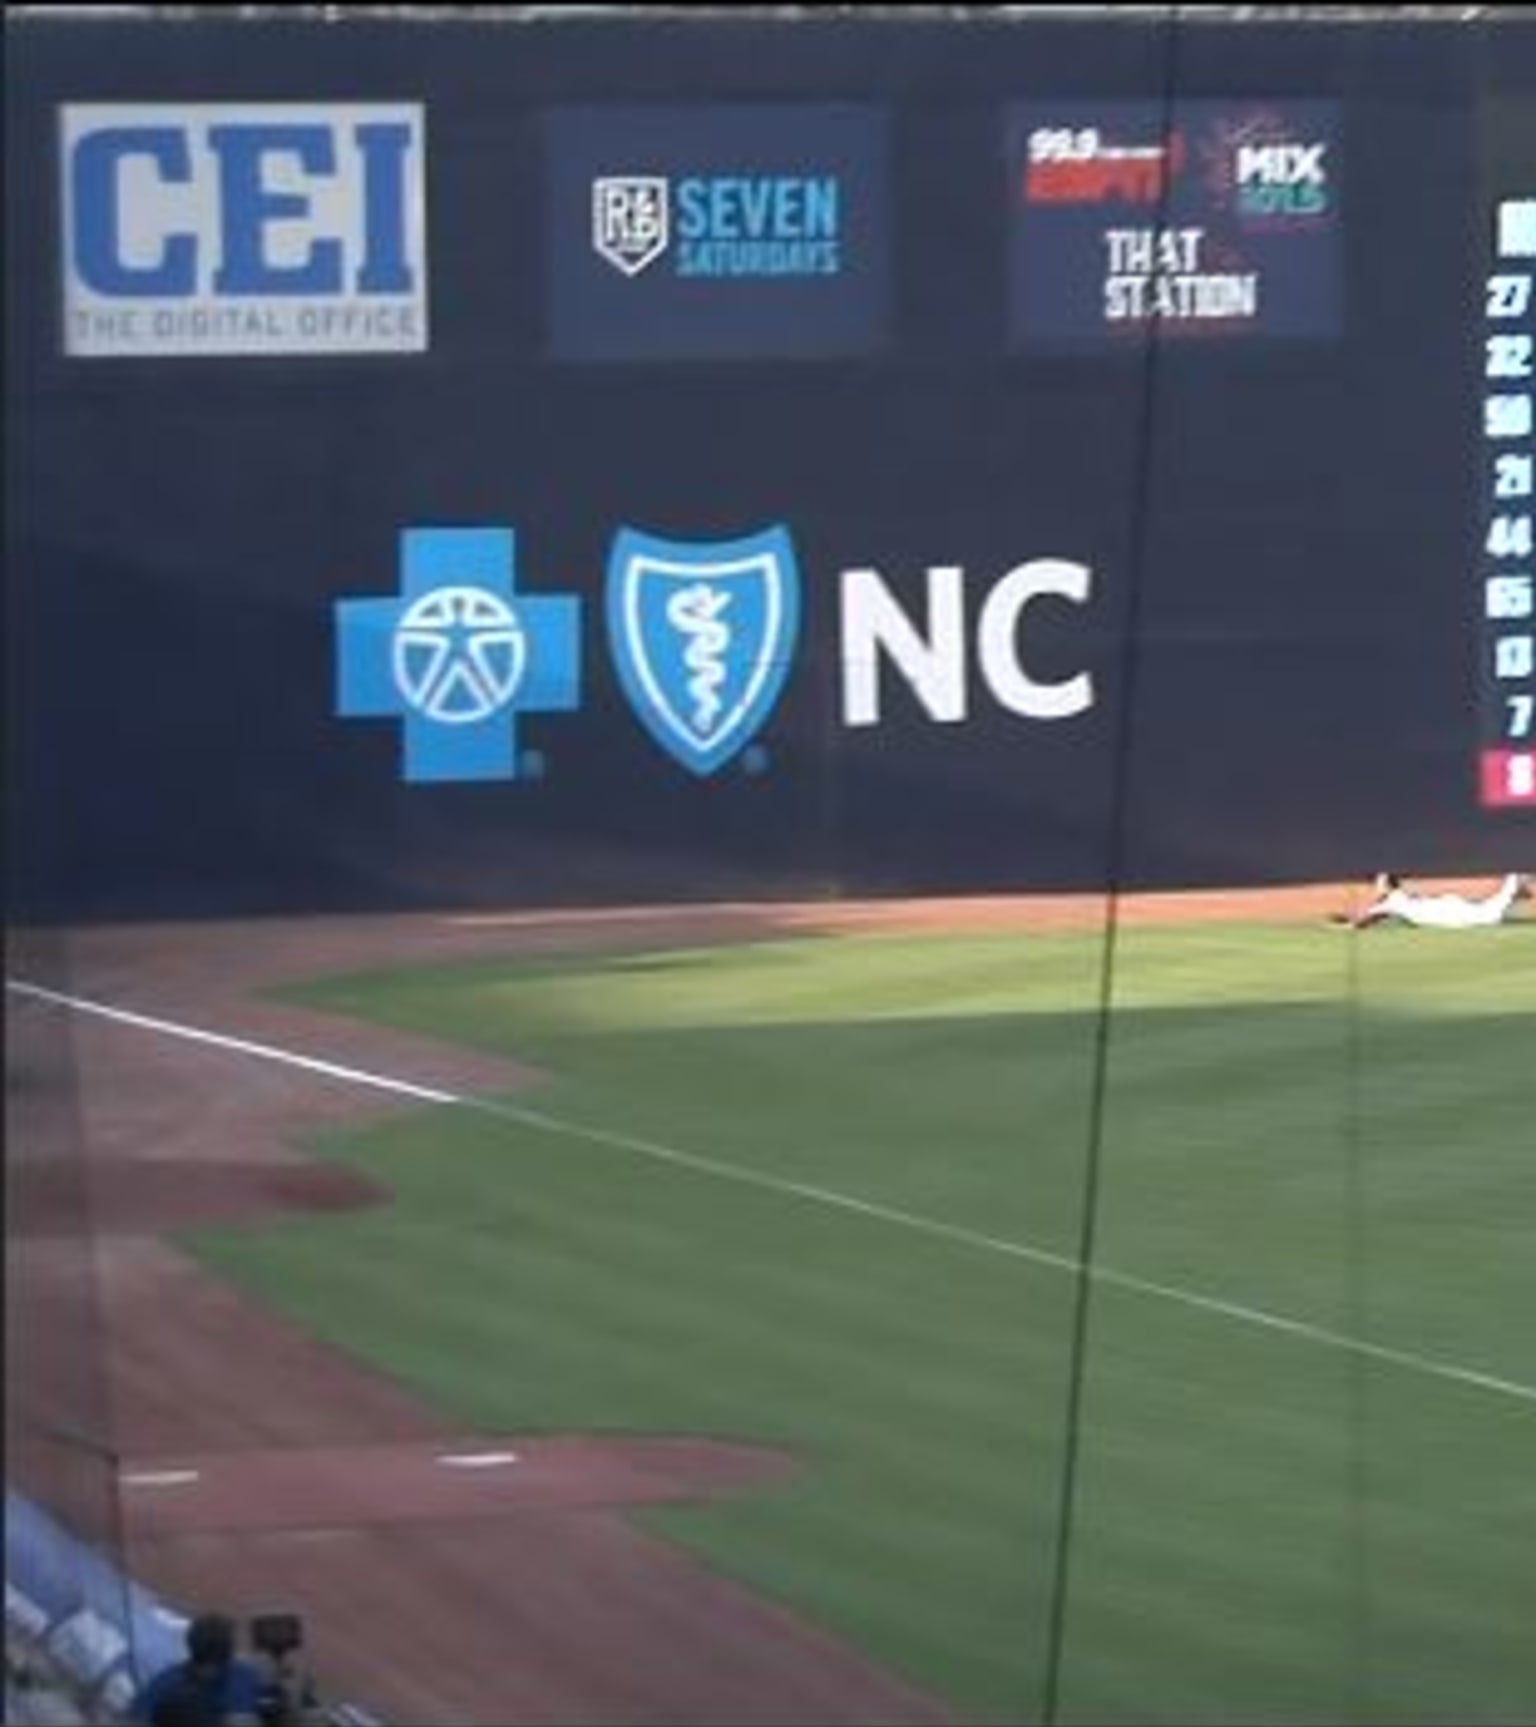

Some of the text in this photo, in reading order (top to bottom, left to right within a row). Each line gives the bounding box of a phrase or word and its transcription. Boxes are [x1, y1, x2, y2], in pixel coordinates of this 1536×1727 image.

[1236, 143, 1327, 186] MIX
[72, 122, 412, 299] CEI
[679, 180, 837, 238] SEVEN
[679, 240, 838, 275] SATURDAYS
[1105, 227, 1205, 274] THAT
[1104, 274, 1259, 320] STATION
[1485, 273, 1533, 319] 27
[76, 304, 419, 341] THE DIGITAL OFFICE
[1485, 514, 1533, 557] 44
[840, 558, 1094, 728] NC
[1506, 695, 1534, 737] 7
